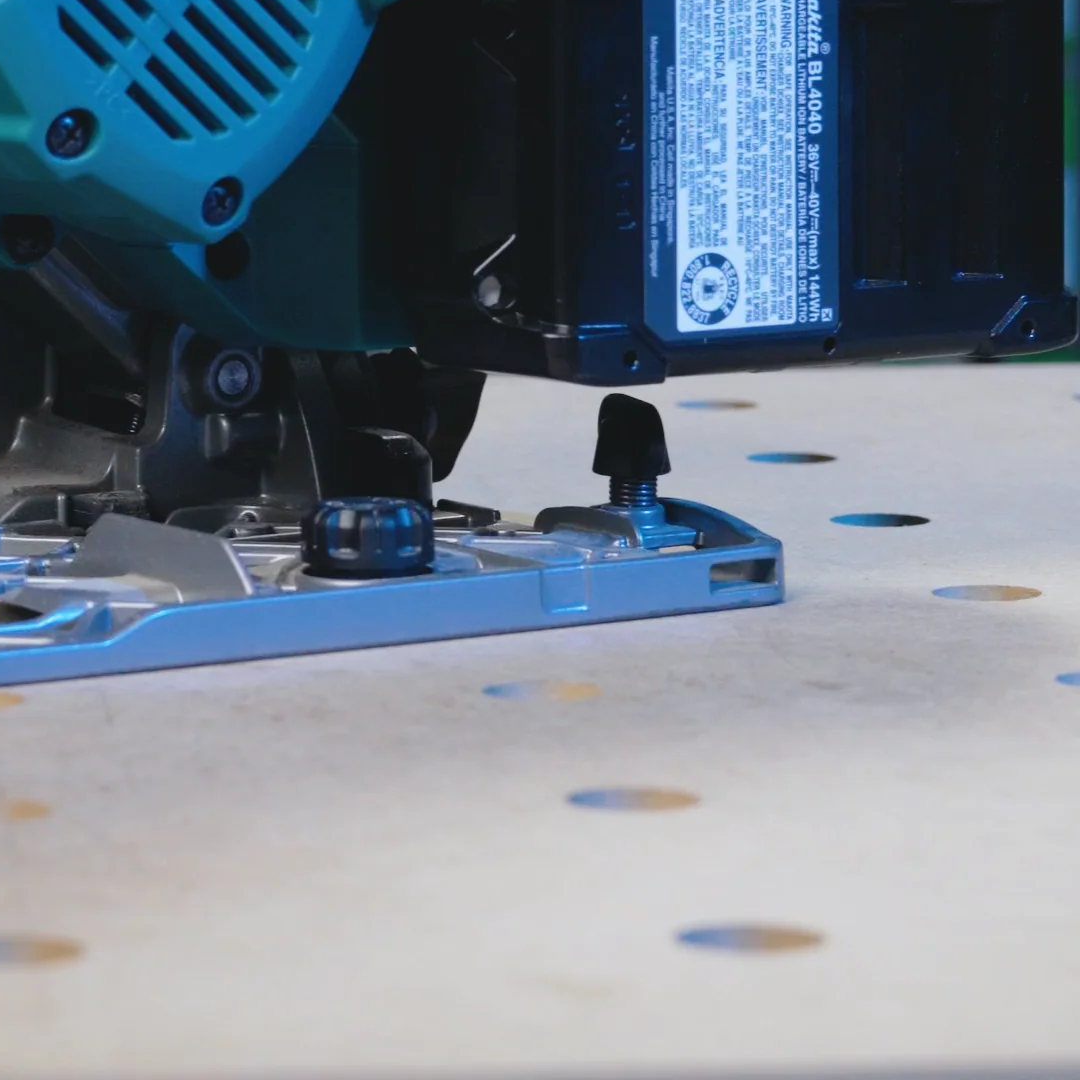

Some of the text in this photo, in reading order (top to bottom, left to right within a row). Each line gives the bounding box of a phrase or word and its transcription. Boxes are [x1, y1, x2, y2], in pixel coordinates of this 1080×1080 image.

[798, 63, 806, 104] LITHIUM
[807, 60, 822, 134] BL4040
[798, 107, 806, 124] ION
[798, 128, 806, 173] BATTERY
[798, 229, 806, 242] DE
[798, 246, 806, 274] IONES
[720, 261, 738, 315] RECYCLE
[798, 280, 806, 294] DE
[807, 274, 822, 322] 144Wh
[798, 297, 806, 323] LITIO
